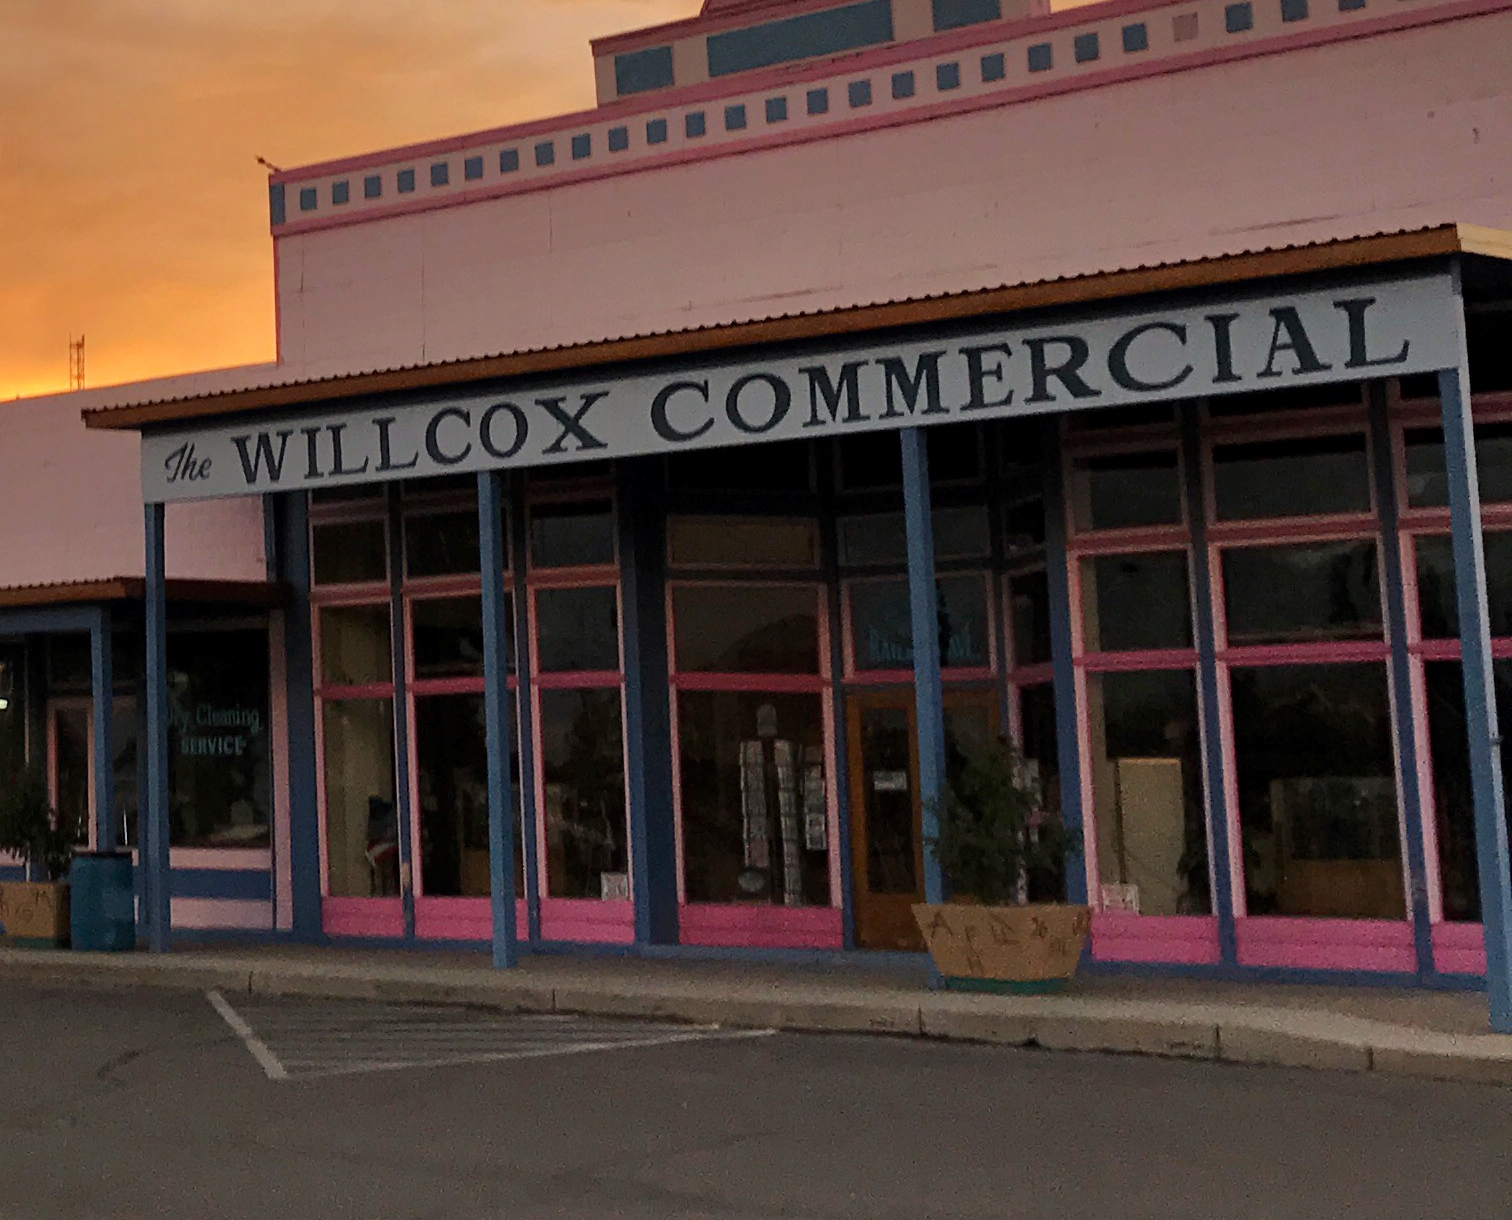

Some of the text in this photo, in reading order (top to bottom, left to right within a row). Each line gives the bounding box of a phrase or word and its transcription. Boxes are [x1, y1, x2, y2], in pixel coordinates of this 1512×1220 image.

[163, 296, 1411, 485] The WILLCOX COMMERCIAL
[181, 735, 247, 756] SERVICE
